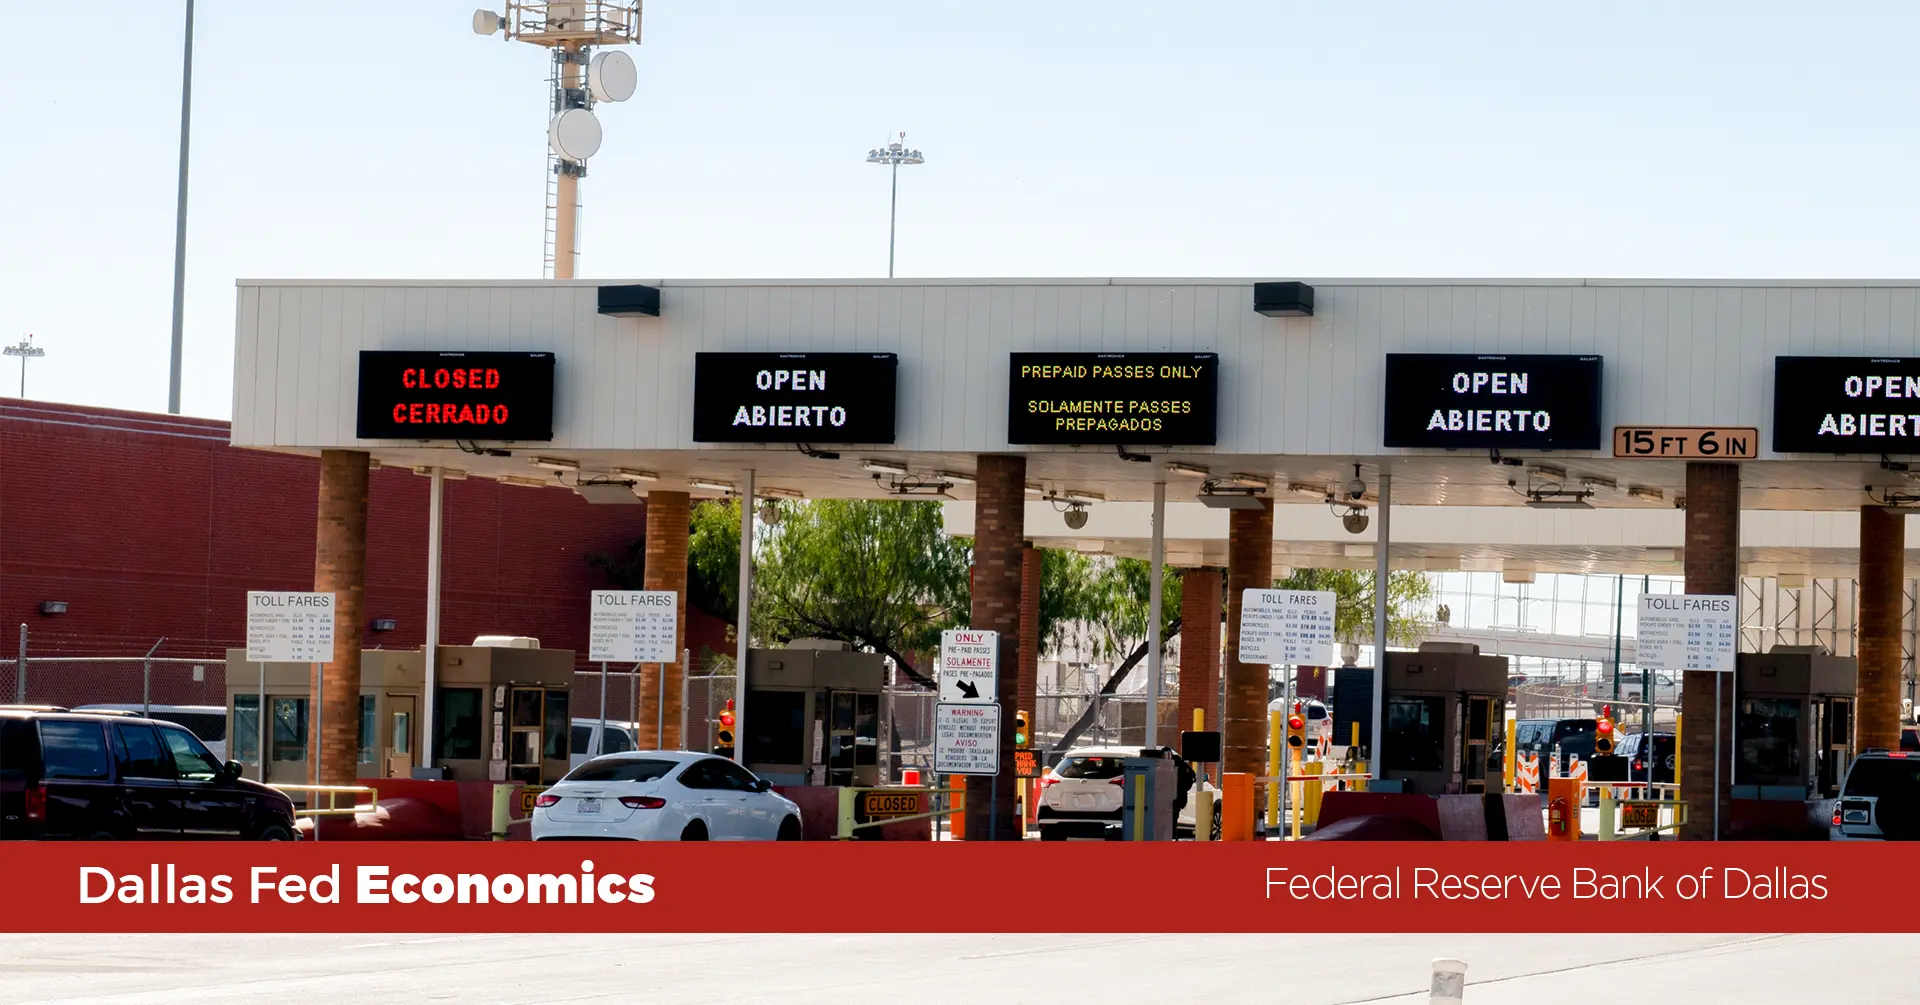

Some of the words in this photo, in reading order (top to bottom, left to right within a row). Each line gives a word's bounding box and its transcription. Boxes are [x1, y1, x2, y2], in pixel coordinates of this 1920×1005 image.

[402, 368, 500, 389] CLOSED
[1022, 366, 1087, 378] PREPAID
[1093, 366, 1154, 378] PASSES
[1160, 366, 1202, 378] ONLY
[756, 370, 826, 390] OPEN
[1453, 373, 1528, 394] OPEN
[1845, 376, 1920, 398] OPEN
[393, 403, 508, 424] CERRADO
[1028, 401, 1123, 413] SOLAMENTE
[1129, 401, 1191, 413] PASSES
[732, 406, 846, 426] ABIERTO
[1426, 410, 1550, 431] ABIERTO
[1056, 418, 1162, 430] PREPAGADOS
[1818, 414, 1920, 436] ABIERT
[1623, 430, 1654, 454] 15
[1661, 437, 1687, 454] FT
[1698, 431, 1719, 455] 6
[1726, 438, 1746, 455] IN
[254, 596, 284, 606] TOLL
[288, 596, 329, 607] FARES
[597, 595, 627, 605] TOLL
[631, 595, 672, 606] FARES
[1262, 594, 1283, 604] TOLL
[1290, 595, 1317, 605] FARES
[1645, 598, 1679, 610] TOLL
[1684, 599, 1730, 611] FARES
[956, 634, 983, 642] ONLY
[947, 657, 991, 666] SOLAMENTE
[869, 798, 915, 811] CLOSED
